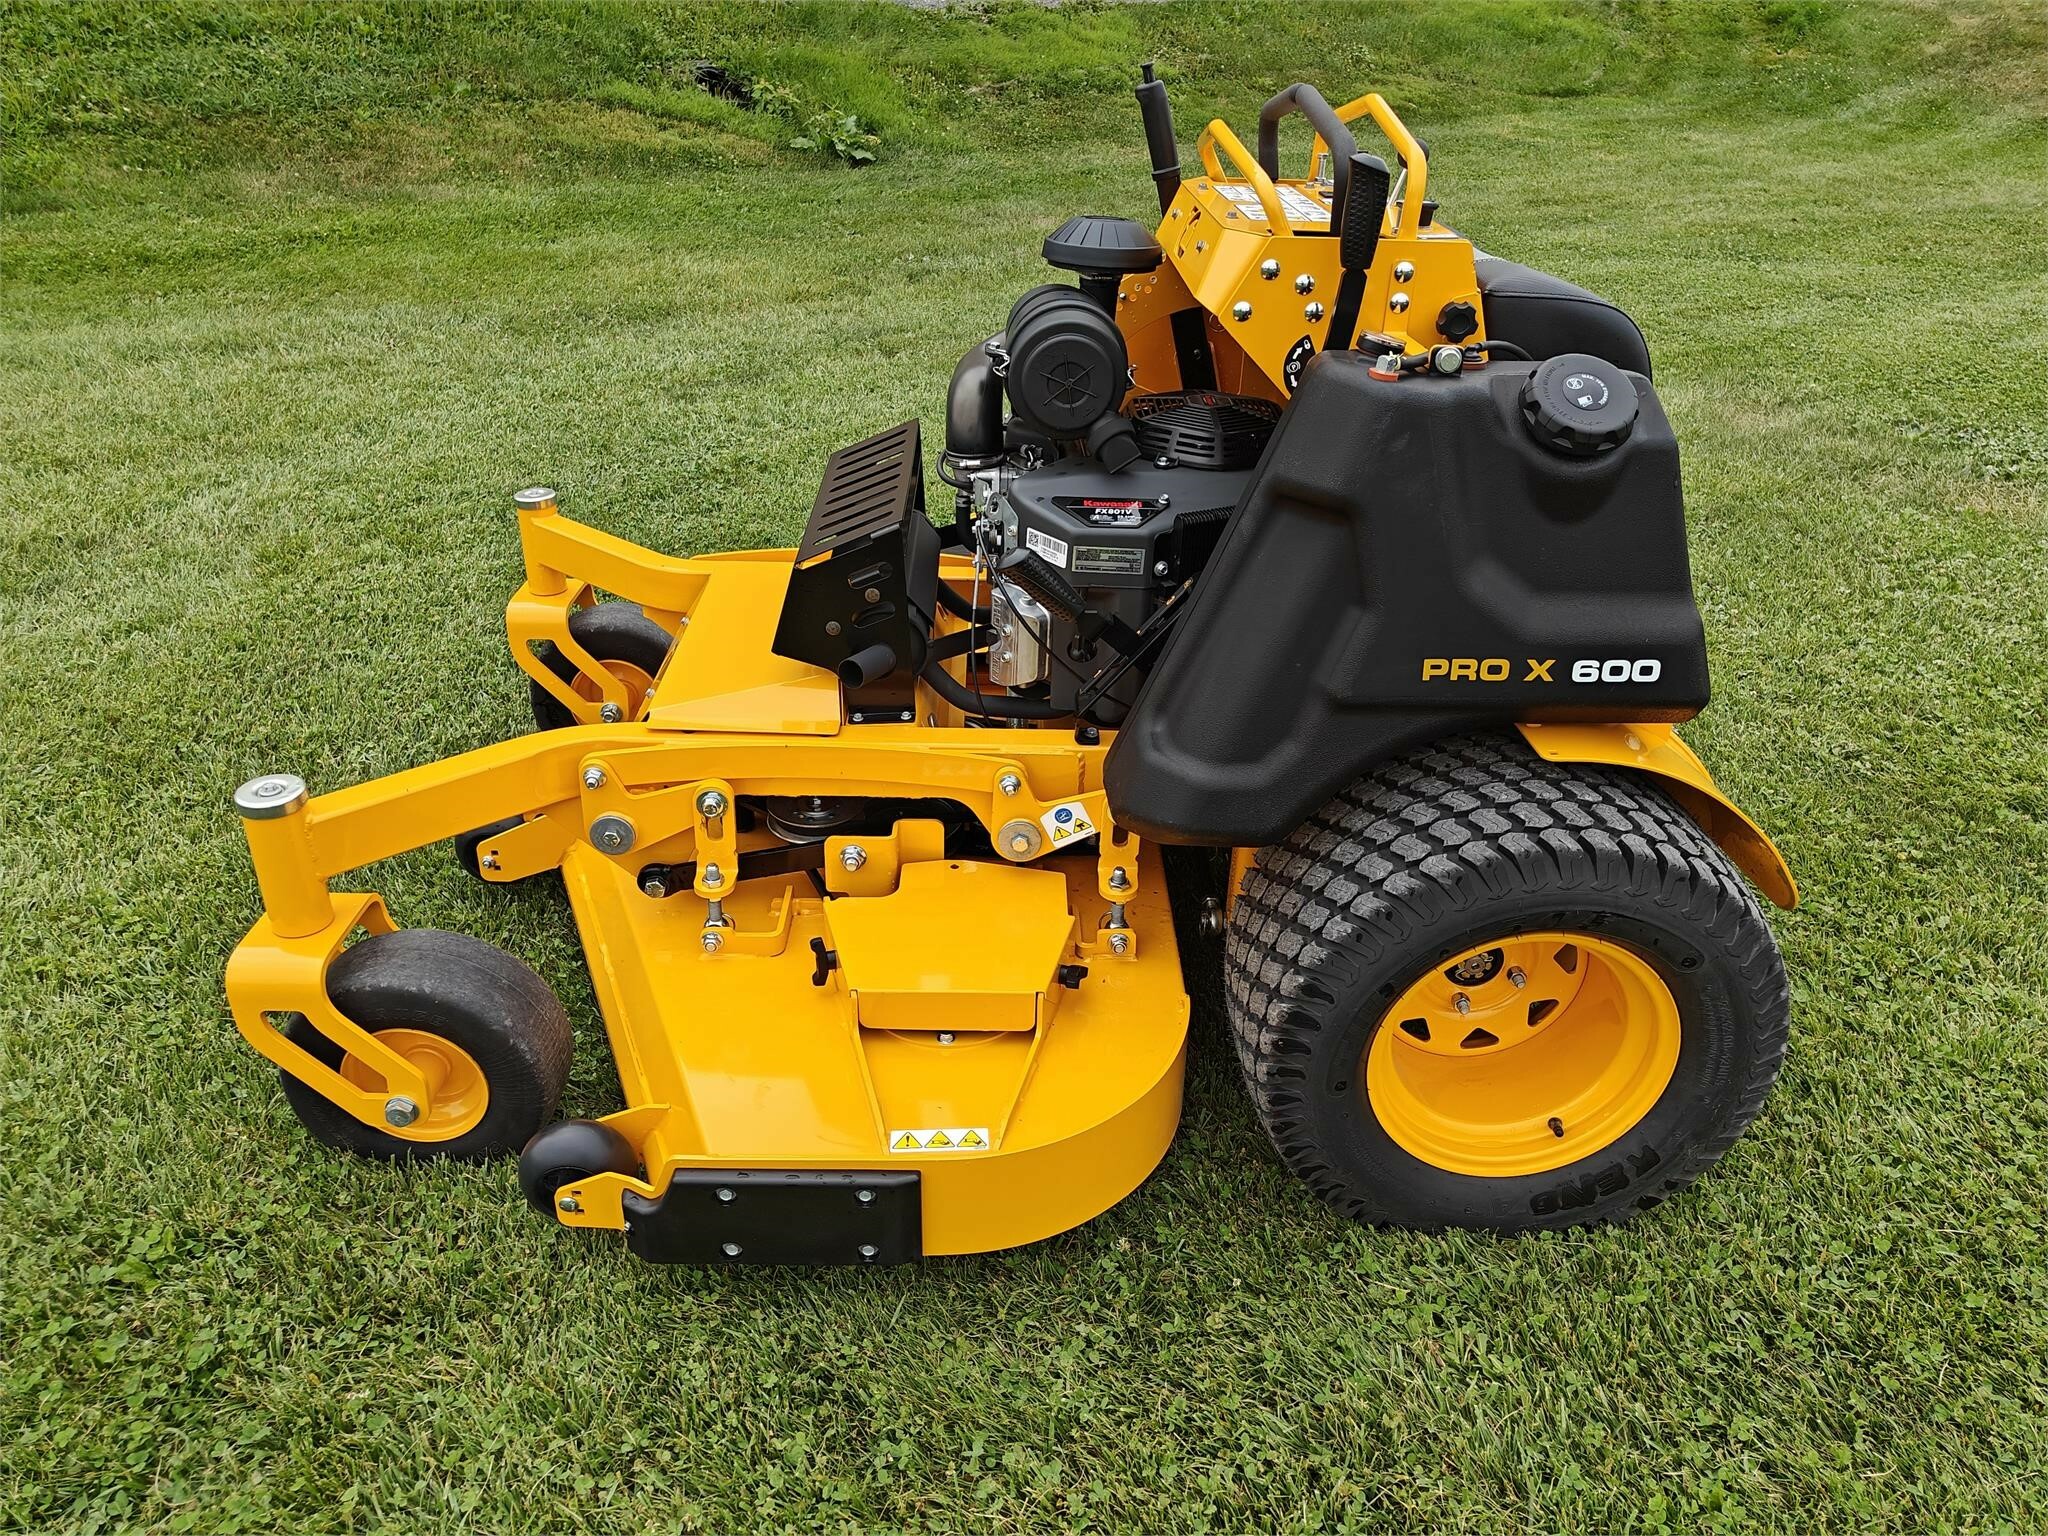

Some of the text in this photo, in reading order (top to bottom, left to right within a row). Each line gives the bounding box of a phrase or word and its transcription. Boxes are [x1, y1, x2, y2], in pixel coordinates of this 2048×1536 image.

[1083, 500, 1143, 508] Kawasaki
[1422, 658, 1662, 683] PRO X 600
